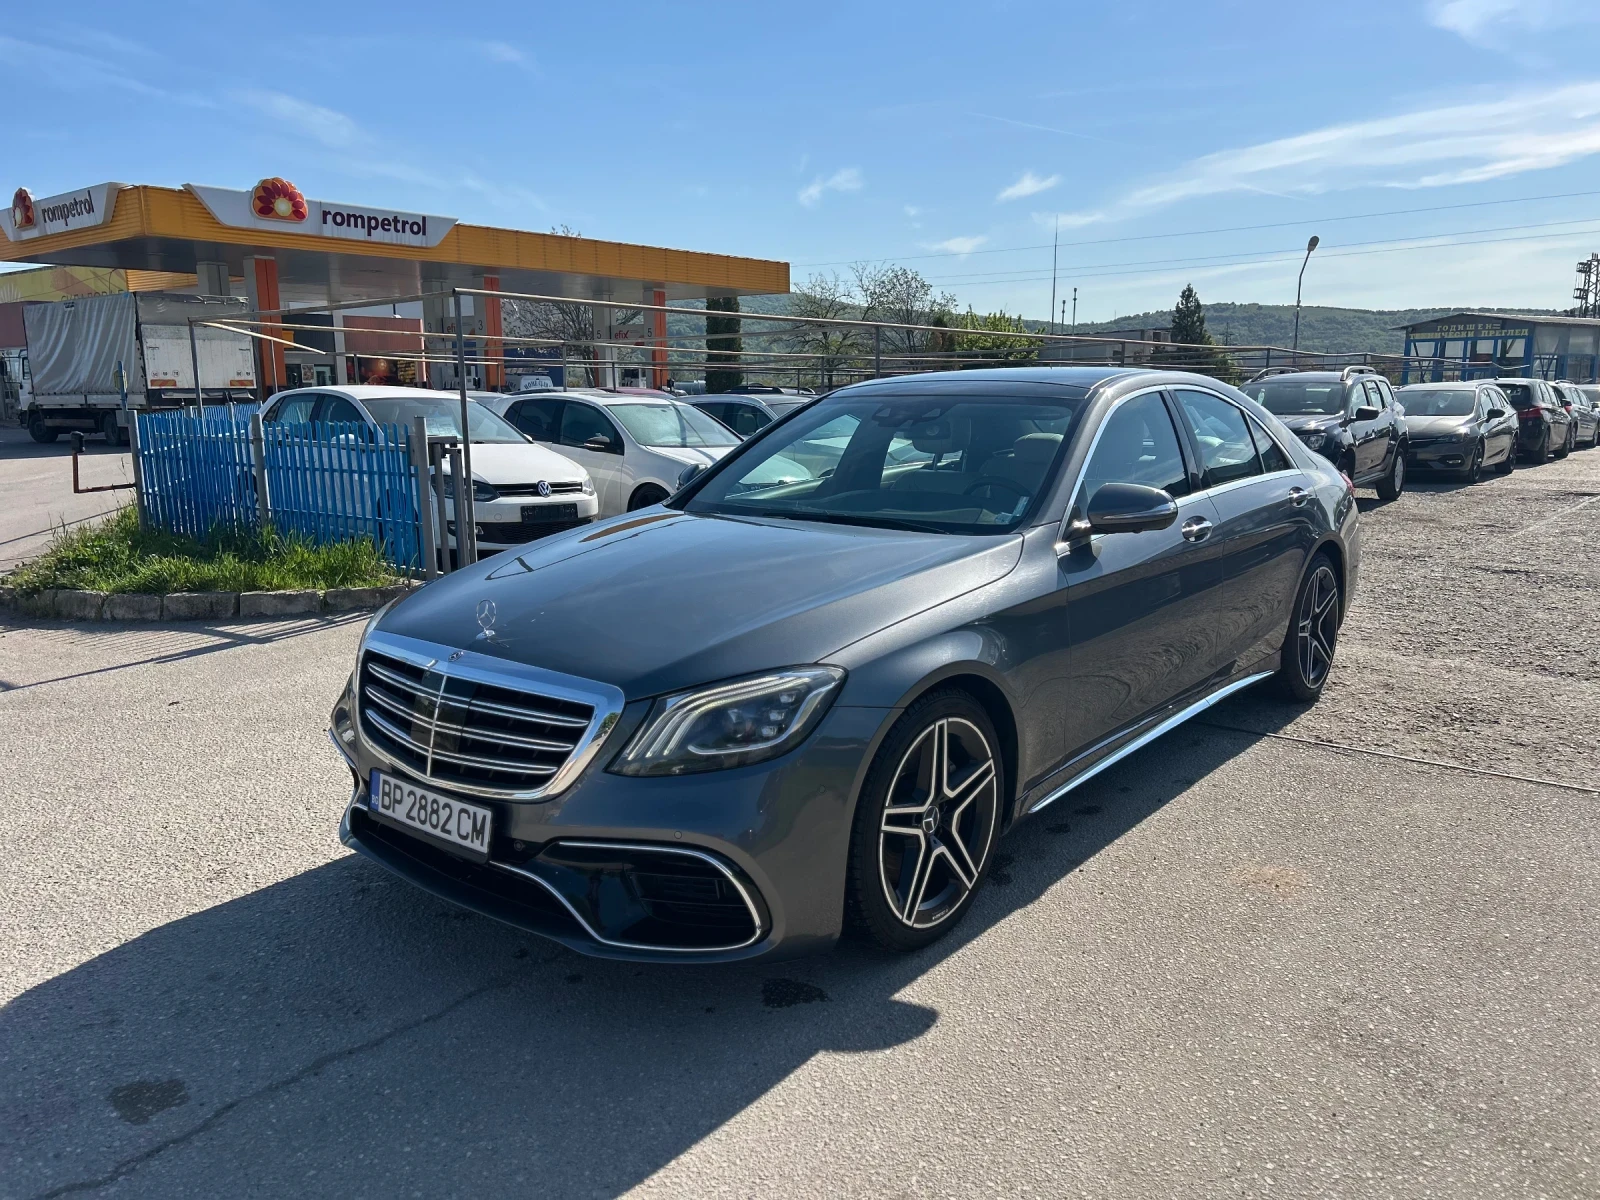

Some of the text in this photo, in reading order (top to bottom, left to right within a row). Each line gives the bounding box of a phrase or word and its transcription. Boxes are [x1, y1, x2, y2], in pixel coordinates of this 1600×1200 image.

[41, 190, 95, 226] rompetrol
[322, 208, 427, 237] rompetrol
[427, 322, 433, 333] 3
[478, 320, 484, 331] 3
[596, 330, 602, 340] 5
[614, 330, 630, 339] efix
[647, 328, 653, 338] 5
[1481, 328, 1529, 337] ПРЕГЛЕД
[371, 794, 379, 805] BG
[381, 779, 487, 847] BP 2882 CM
